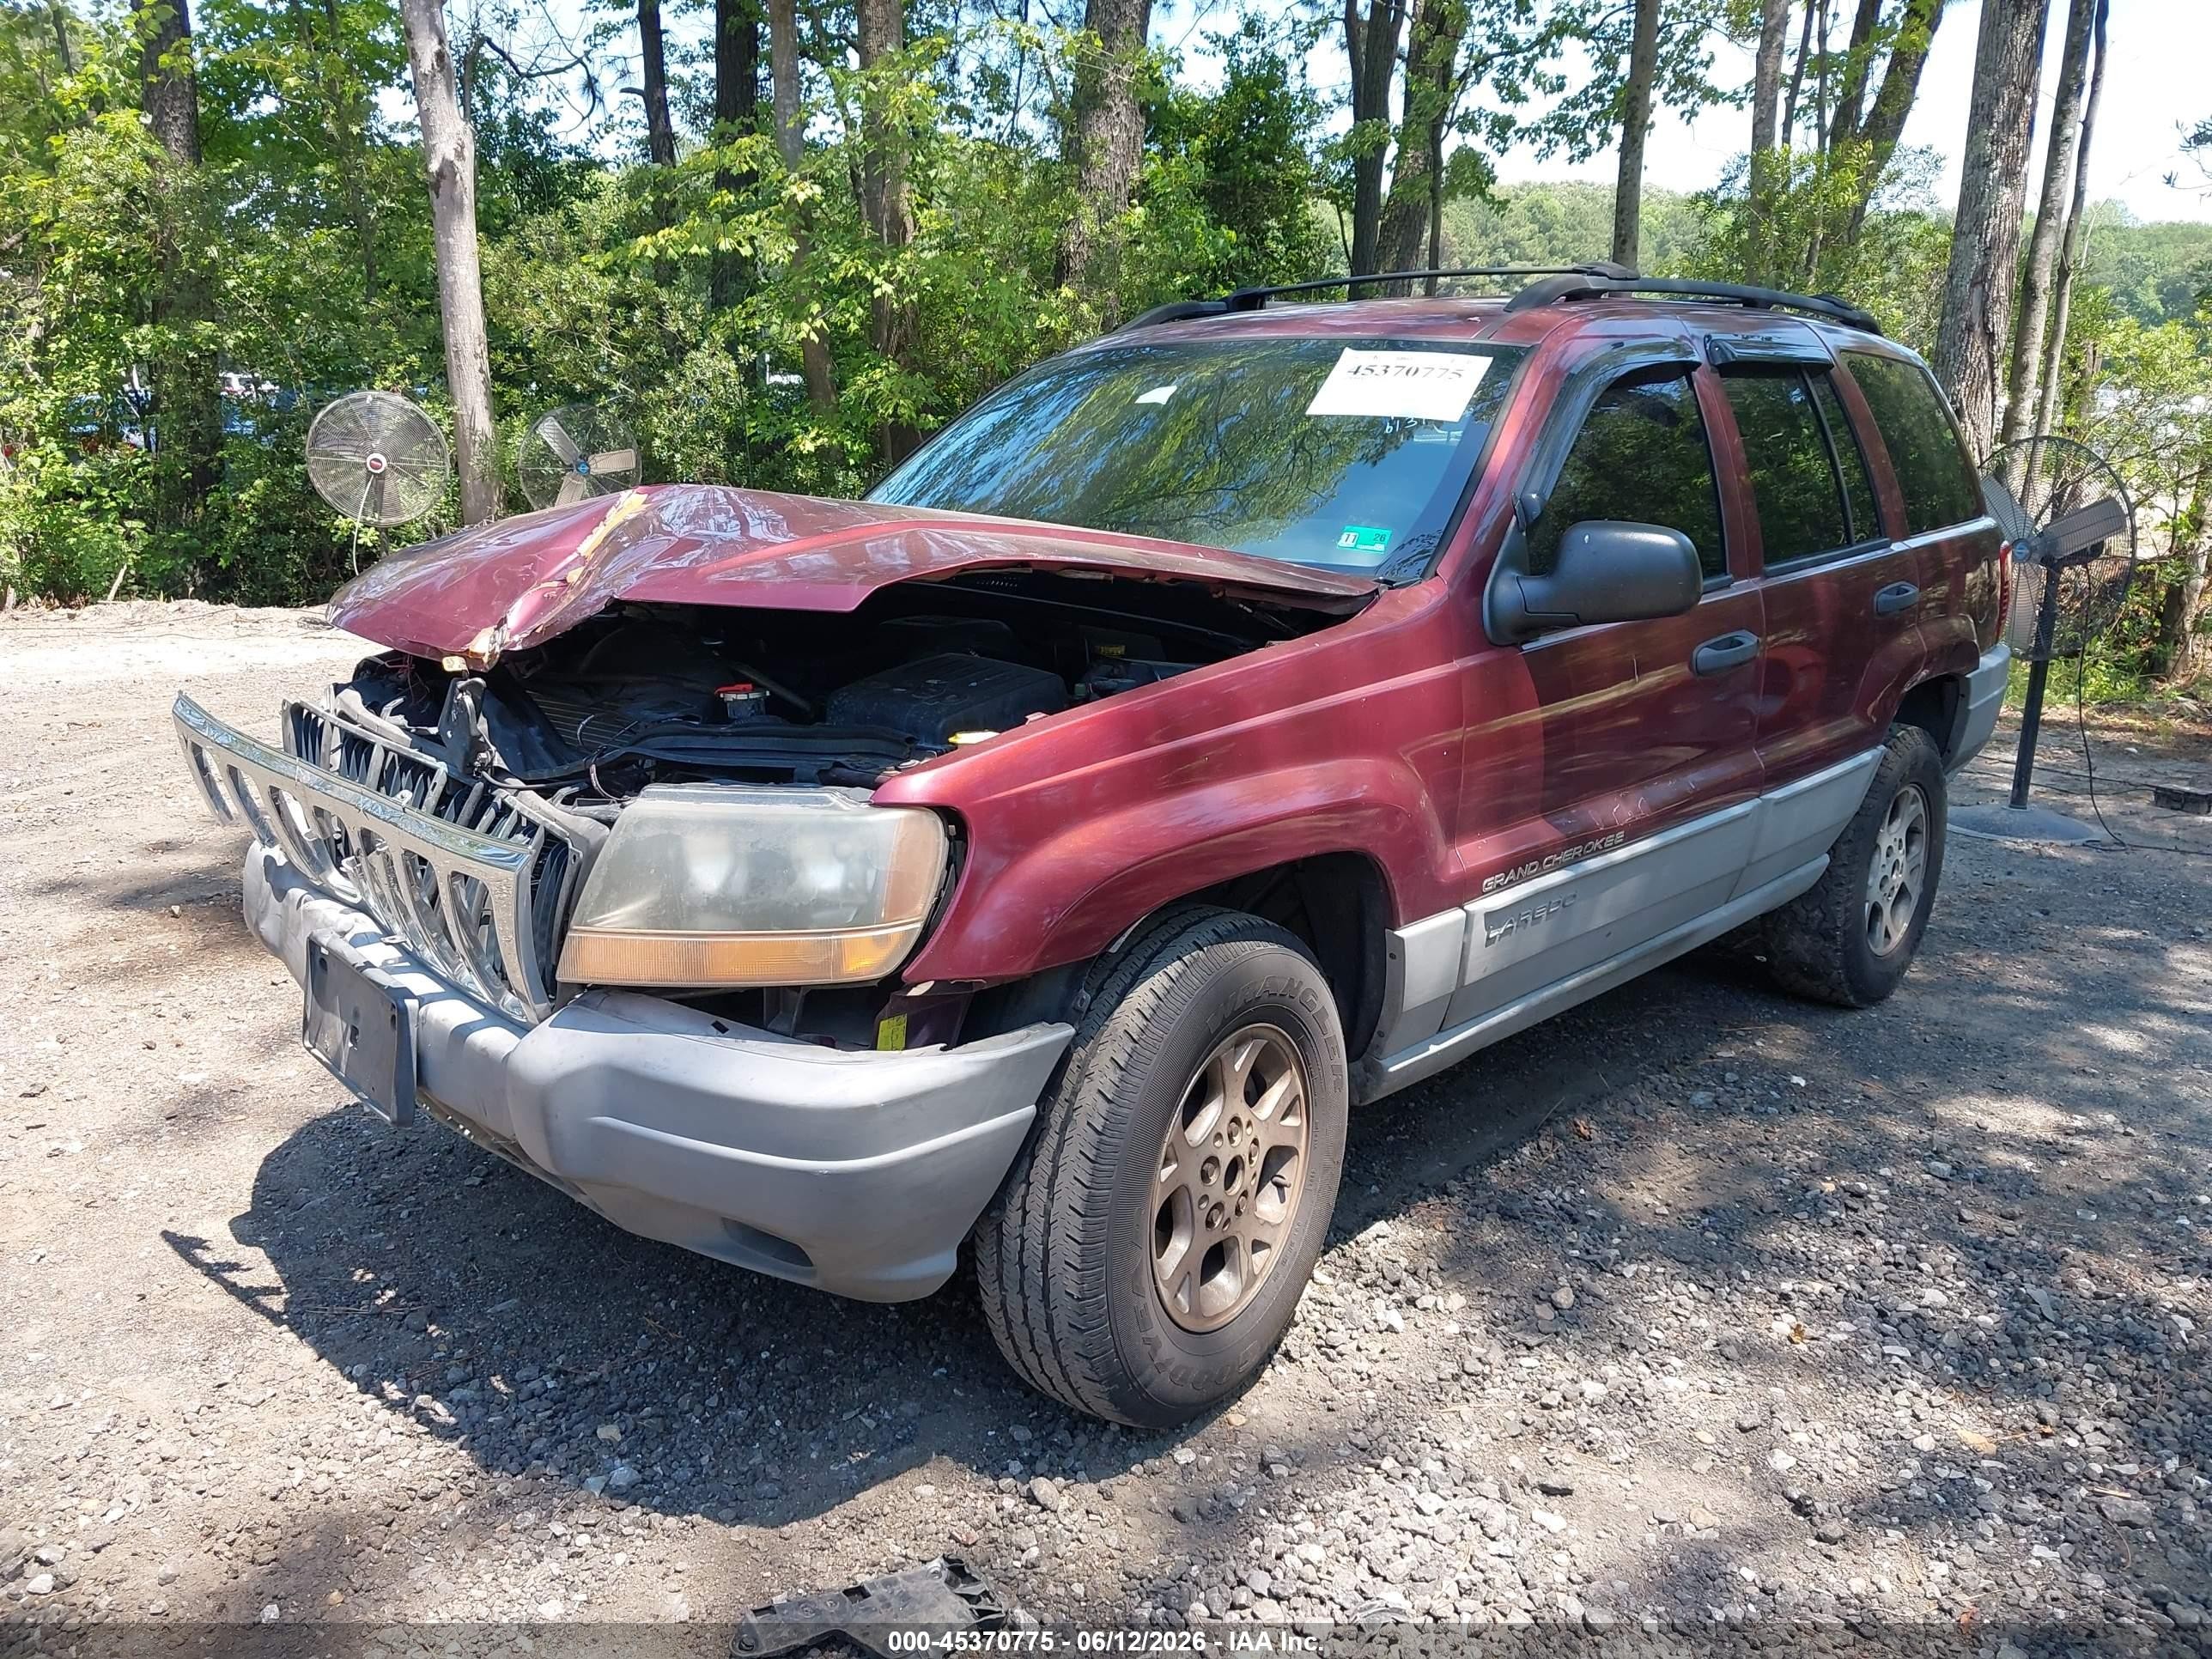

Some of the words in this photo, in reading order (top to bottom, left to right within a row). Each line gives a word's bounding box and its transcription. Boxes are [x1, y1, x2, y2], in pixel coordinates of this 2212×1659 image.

[1347, 365, 1464, 379] 45370775
[1344, 533, 1358, 543] 11
[1373, 533, 1387, 543] 26
[1483, 861, 1539, 892] GRAND
[1543, 831, 1625, 868] CHEROKEE
[1206, 975, 1344, 1093] WRANGLER
